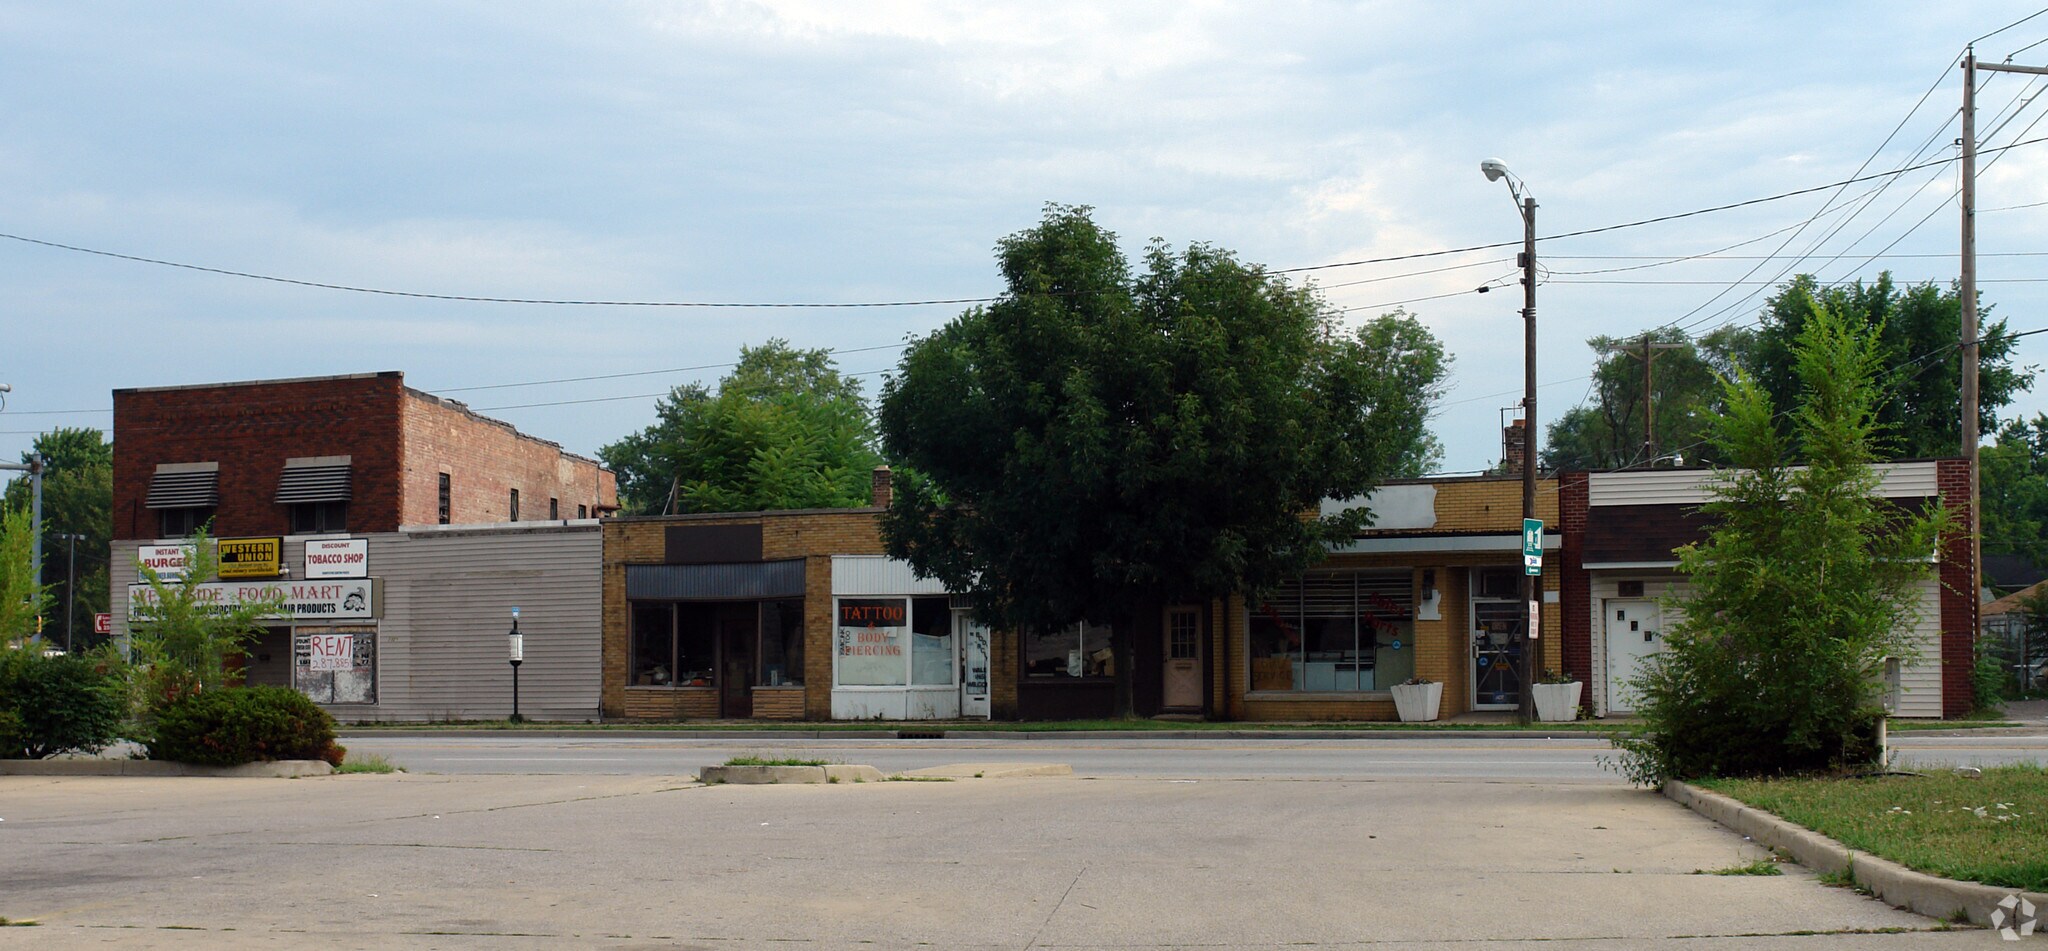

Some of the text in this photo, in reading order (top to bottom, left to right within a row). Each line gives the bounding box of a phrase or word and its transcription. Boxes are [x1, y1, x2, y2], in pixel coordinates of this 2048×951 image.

[222, 543, 272, 553] WESTERN
[237, 552, 272, 562] UNION
[308, 553, 364, 564] TOBACCO SHOP
[238, 586, 283, 601] FOOD
[291, 585, 344, 600] MART
[297, 603, 336, 614] PRODUCTS
[841, 606, 903, 620] TATTOO
[857, 631, 889, 643] BODY
[312, 636, 353, 657] RENT
[845, 645, 901, 656] PIERCING
